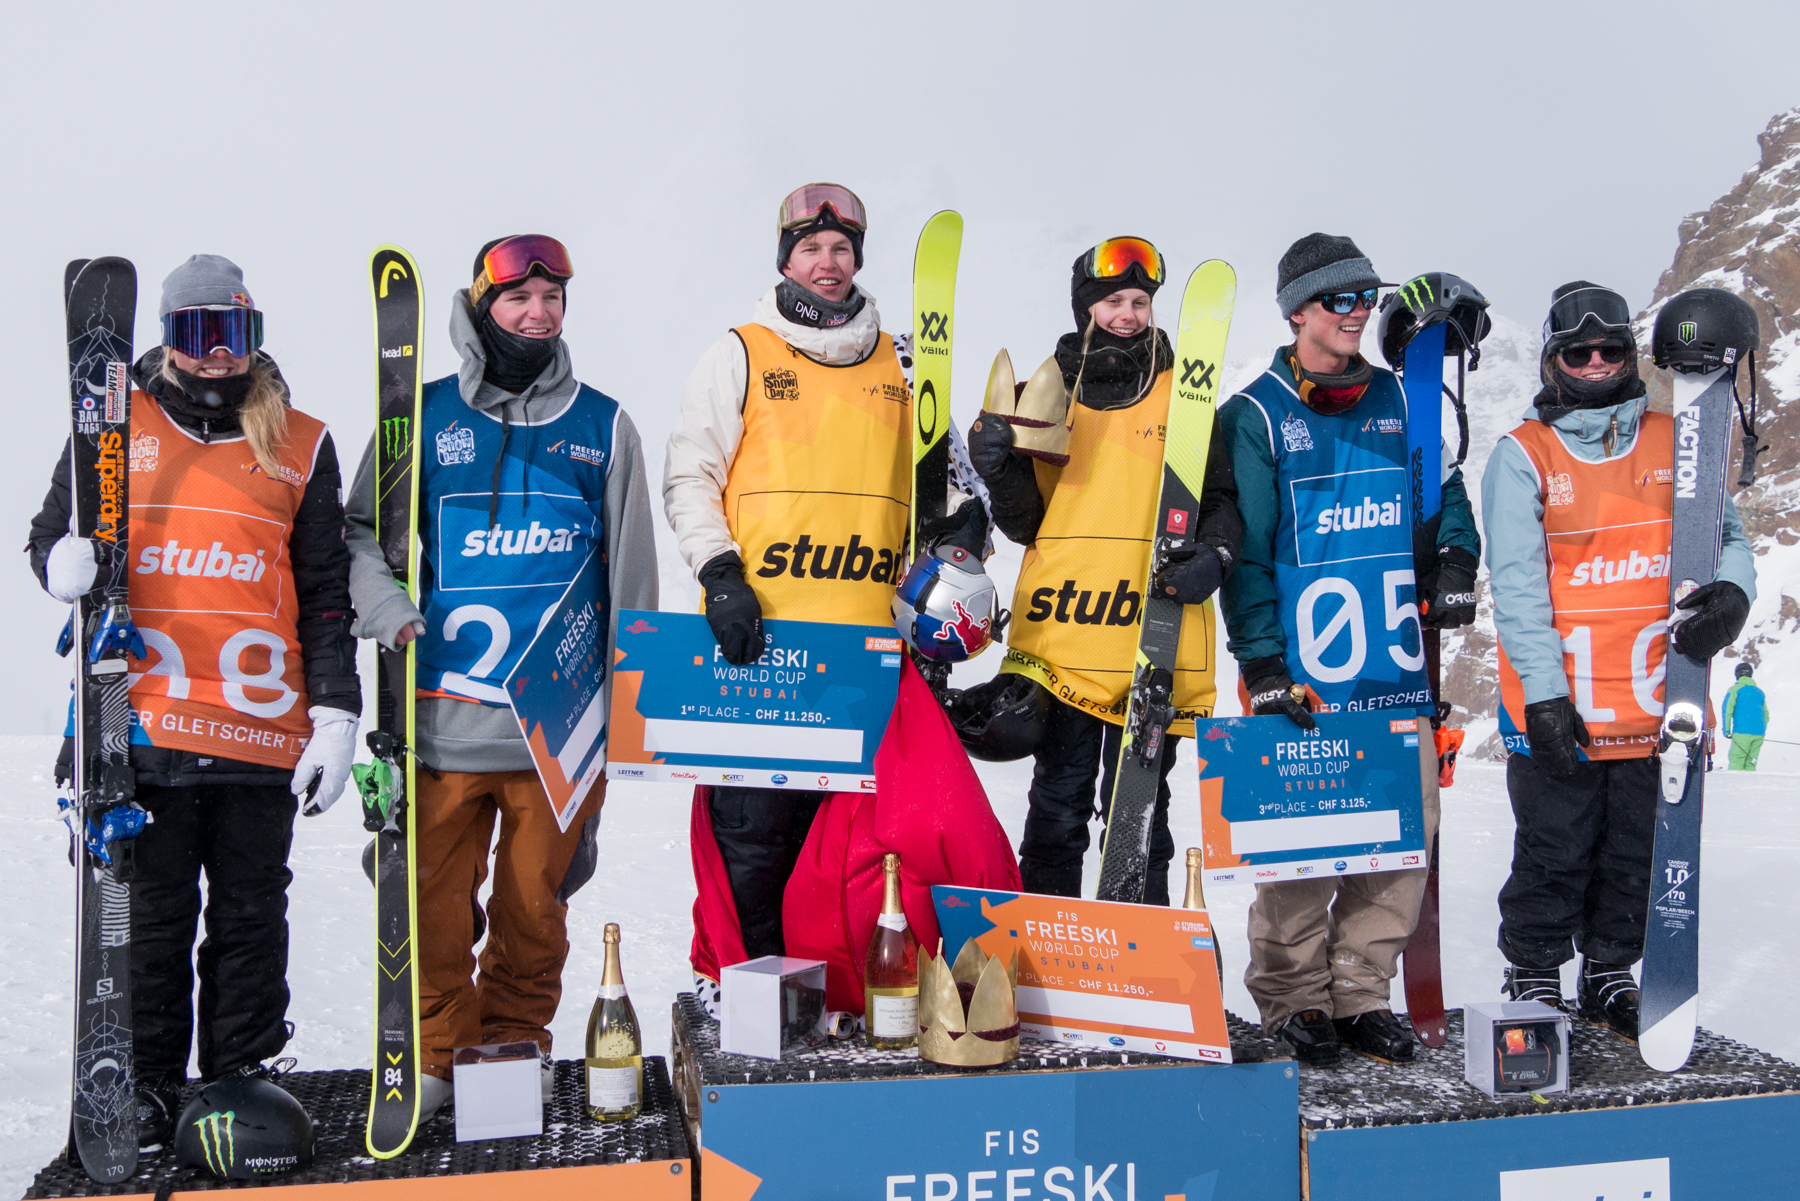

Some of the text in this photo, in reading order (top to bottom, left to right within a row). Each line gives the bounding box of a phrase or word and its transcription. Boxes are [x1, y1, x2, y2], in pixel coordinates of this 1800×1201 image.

[795, 301, 819, 320] DNB
[381, 346, 402, 359] head
[920, 345, 949, 356] Völkl
[108, 363, 118, 392] TEAM
[117, 364, 125, 392] FREESKI
[764, 376, 795, 389] Snow
[770, 389, 785, 399] Day
[1178, 390, 1212, 404] Völkl
[78, 410, 99, 422] BAW
[77, 423, 100, 434] BAGS
[129, 445, 157, 459] now
[438, 437, 472, 453] Snow
[570, 443, 605, 459] FREESKI
[1676, 405, 1700, 498] FACTION
[442, 451, 460, 463] Day
[570, 451, 592, 461] WORLD
[274, 464, 305, 482] REESKI
[1653, 468, 1672, 476] FREE
[1315, 494, 1401, 534] stubai
[461, 521, 581, 557] stubai
[135, 540, 265, 583] stubai
[1568, 550, 1671, 586] stubai
[1445, 593, 1476, 605] OAKLE
[563, 608, 575, 627] FIS
[555, 600, 595, 667] FREESKI
[585, 620, 599, 645] CUP
[572, 639, 603, 690] STUBAI
[774, 670, 807, 685] CUP
[720, 685, 798, 701] STUBAI
[574, 688, 592, 716] PLACE
[680, 704, 696, 716] 1st
[699, 706, 740, 718] PLACE
[755, 708, 781, 721] CHF
[784, 710, 831, 725] 11.250,-
[161, 713, 286, 749] GLETSCHER
[1304, 727, 1320, 737] FIS
[1276, 739, 1350, 760] FREESKI
[1325, 760, 1350, 774] CUP
[1285, 777, 1345, 792] STUBAI
[1274, 801, 1307, 814] PLACE
[1318, 799, 1338, 810] CHF
[1340, 797, 1372, 810] 3.125,-
[1665, 868, 1689, 884] 1.0
[1667, 890, 1686, 901] 170
[1057, 911, 1078, 922] FIS
[1655, 905, 1695, 915] POPLAR/BEECH
[1025, 920, 1118, 946] FREESKI
[1089, 946, 1119, 960] CUP
[1041, 957, 1115, 973] STUBAI
[1025, 972, 1064, 986] PLACE
[1079, 978, 1102, 990] CHF
[1107, 982, 1154, 997] 11.250,-
[86, 991, 123, 1006] salomon
[384, 1067, 403, 1087] 84
[985, 1129, 1040, 1157] FIS
[106, 1164, 125, 1177] 170
[886, 1162, 1136, 1201] FREESKI
